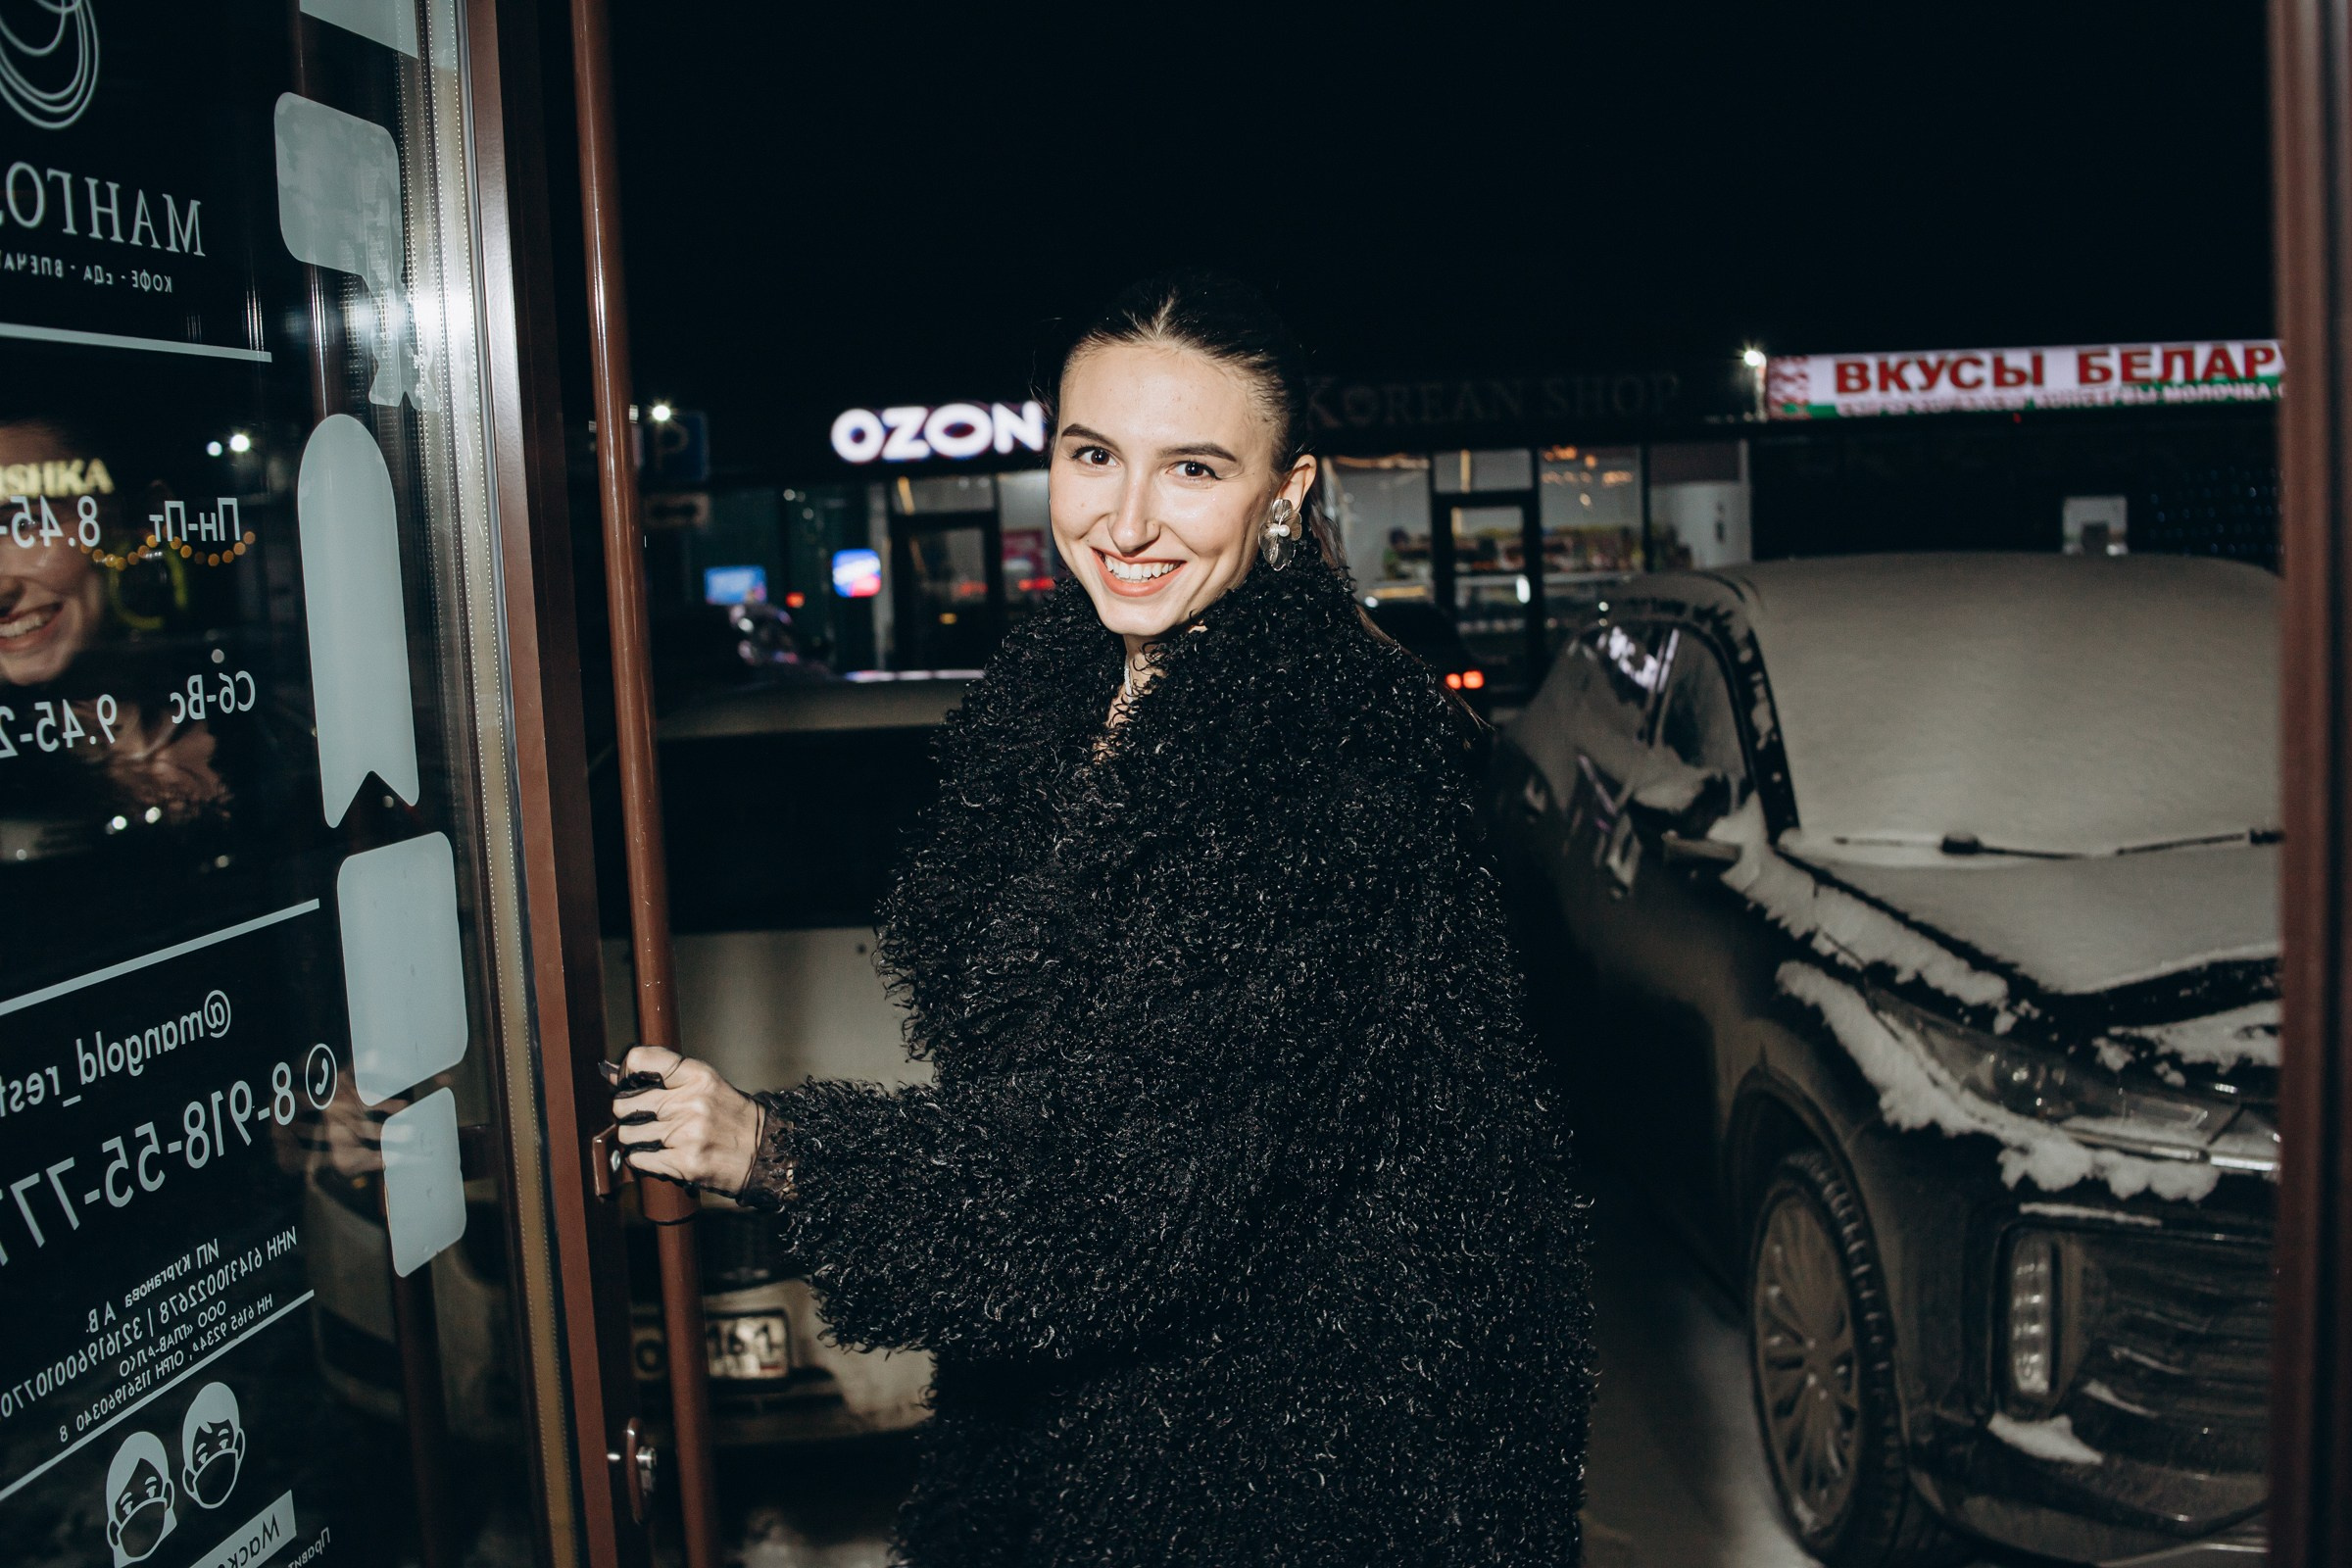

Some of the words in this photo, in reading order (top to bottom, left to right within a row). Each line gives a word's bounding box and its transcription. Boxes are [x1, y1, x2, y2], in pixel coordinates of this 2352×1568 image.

[1835, 351, 2043, 394] ВКУСЫ
[2077, 345, 2276, 385] БЕЛАР
[1304, 375, 1524, 431] KOREAN
[1544, 372, 1680, 418] SHOP
[831, 400, 1045, 463] OZON
